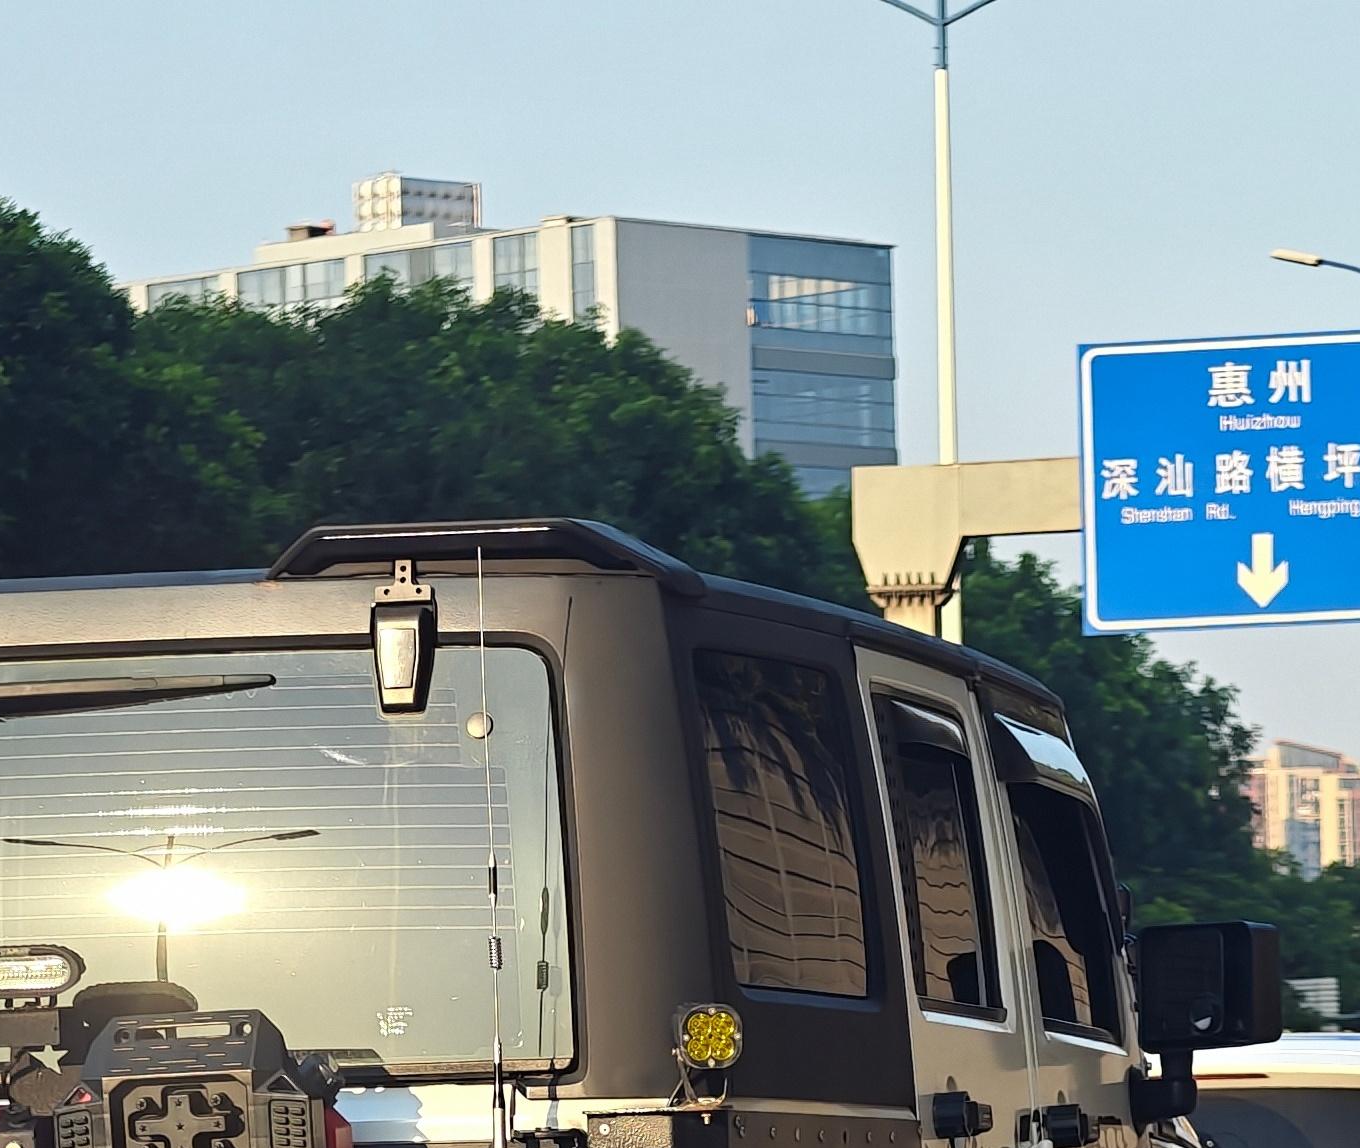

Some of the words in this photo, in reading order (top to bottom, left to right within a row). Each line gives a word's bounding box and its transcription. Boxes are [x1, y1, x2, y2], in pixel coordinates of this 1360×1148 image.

[1207, 359, 1312, 407] 惠州
[1219, 412, 1301, 431] Huizhou
[1121, 505, 1193, 524] Shenshan
